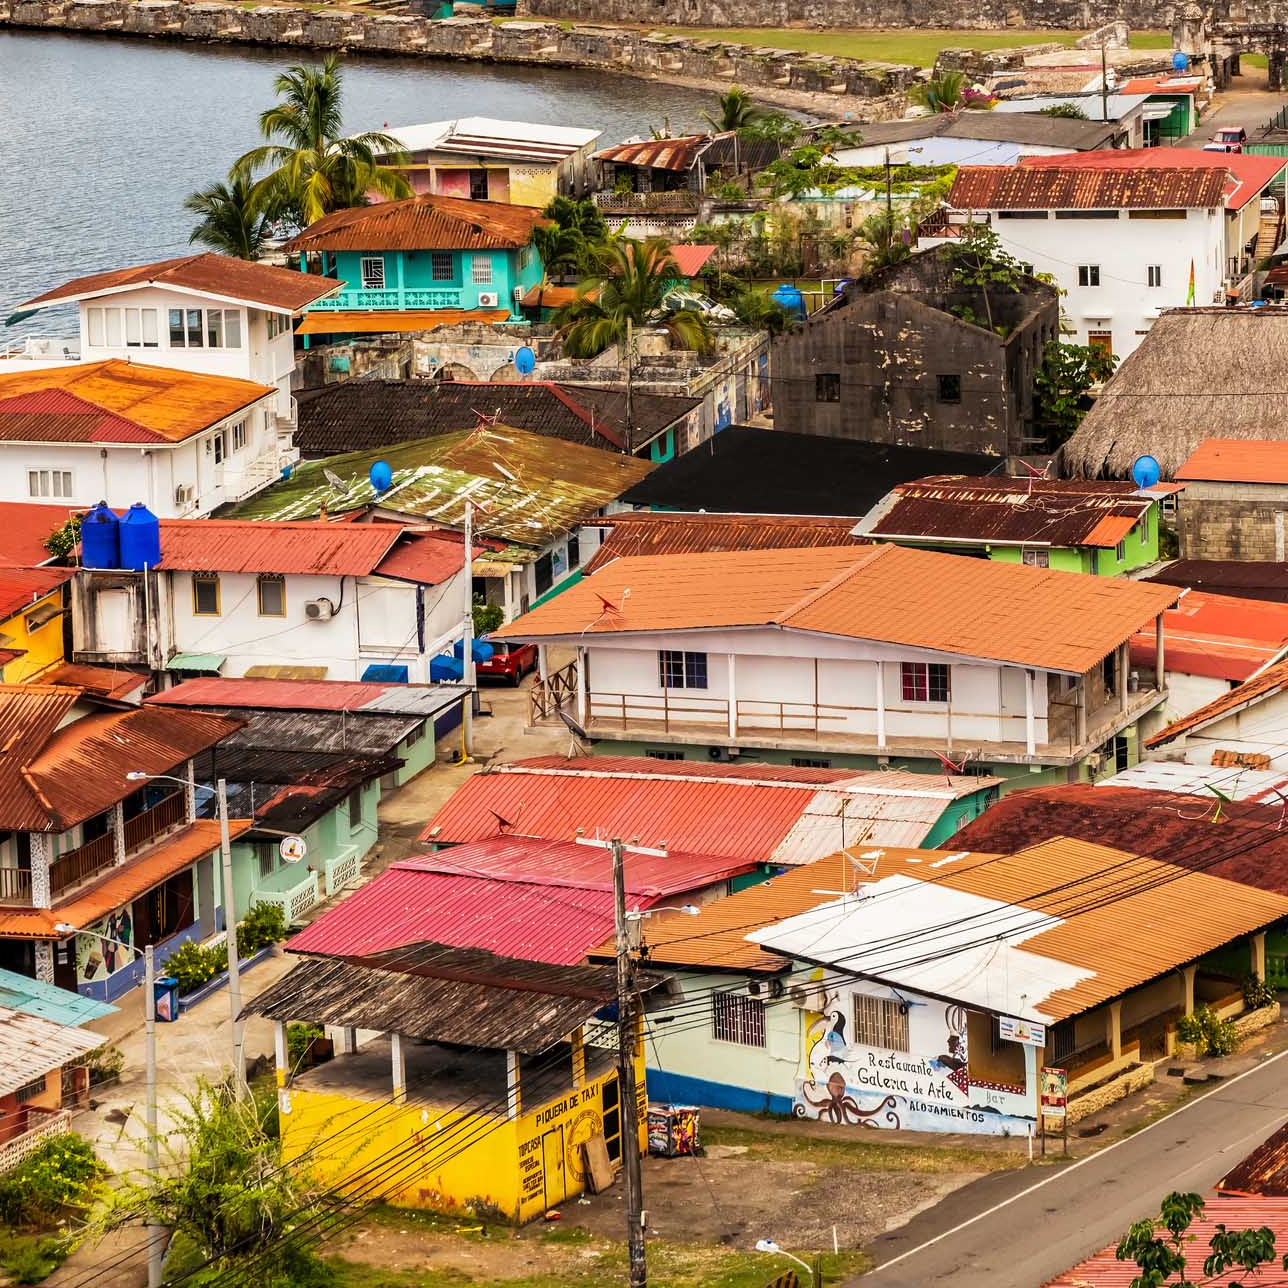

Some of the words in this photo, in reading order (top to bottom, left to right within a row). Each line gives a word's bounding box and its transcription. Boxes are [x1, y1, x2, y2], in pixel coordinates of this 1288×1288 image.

[868, 1052, 934, 1077] Restaurante
[857, 1067, 908, 1092] Galeria
[913, 1082, 924, 1095] de
[927, 1081, 954, 1101] Arte
[536, 1099, 568, 1127] PIQUERA
[569, 1094, 579, 1109] DE
[581, 1083, 599, 1103] TAXI
[985, 1090, 1006, 1105] Bar
[909, 1099, 985, 1123] ALOJAMIENTOS
